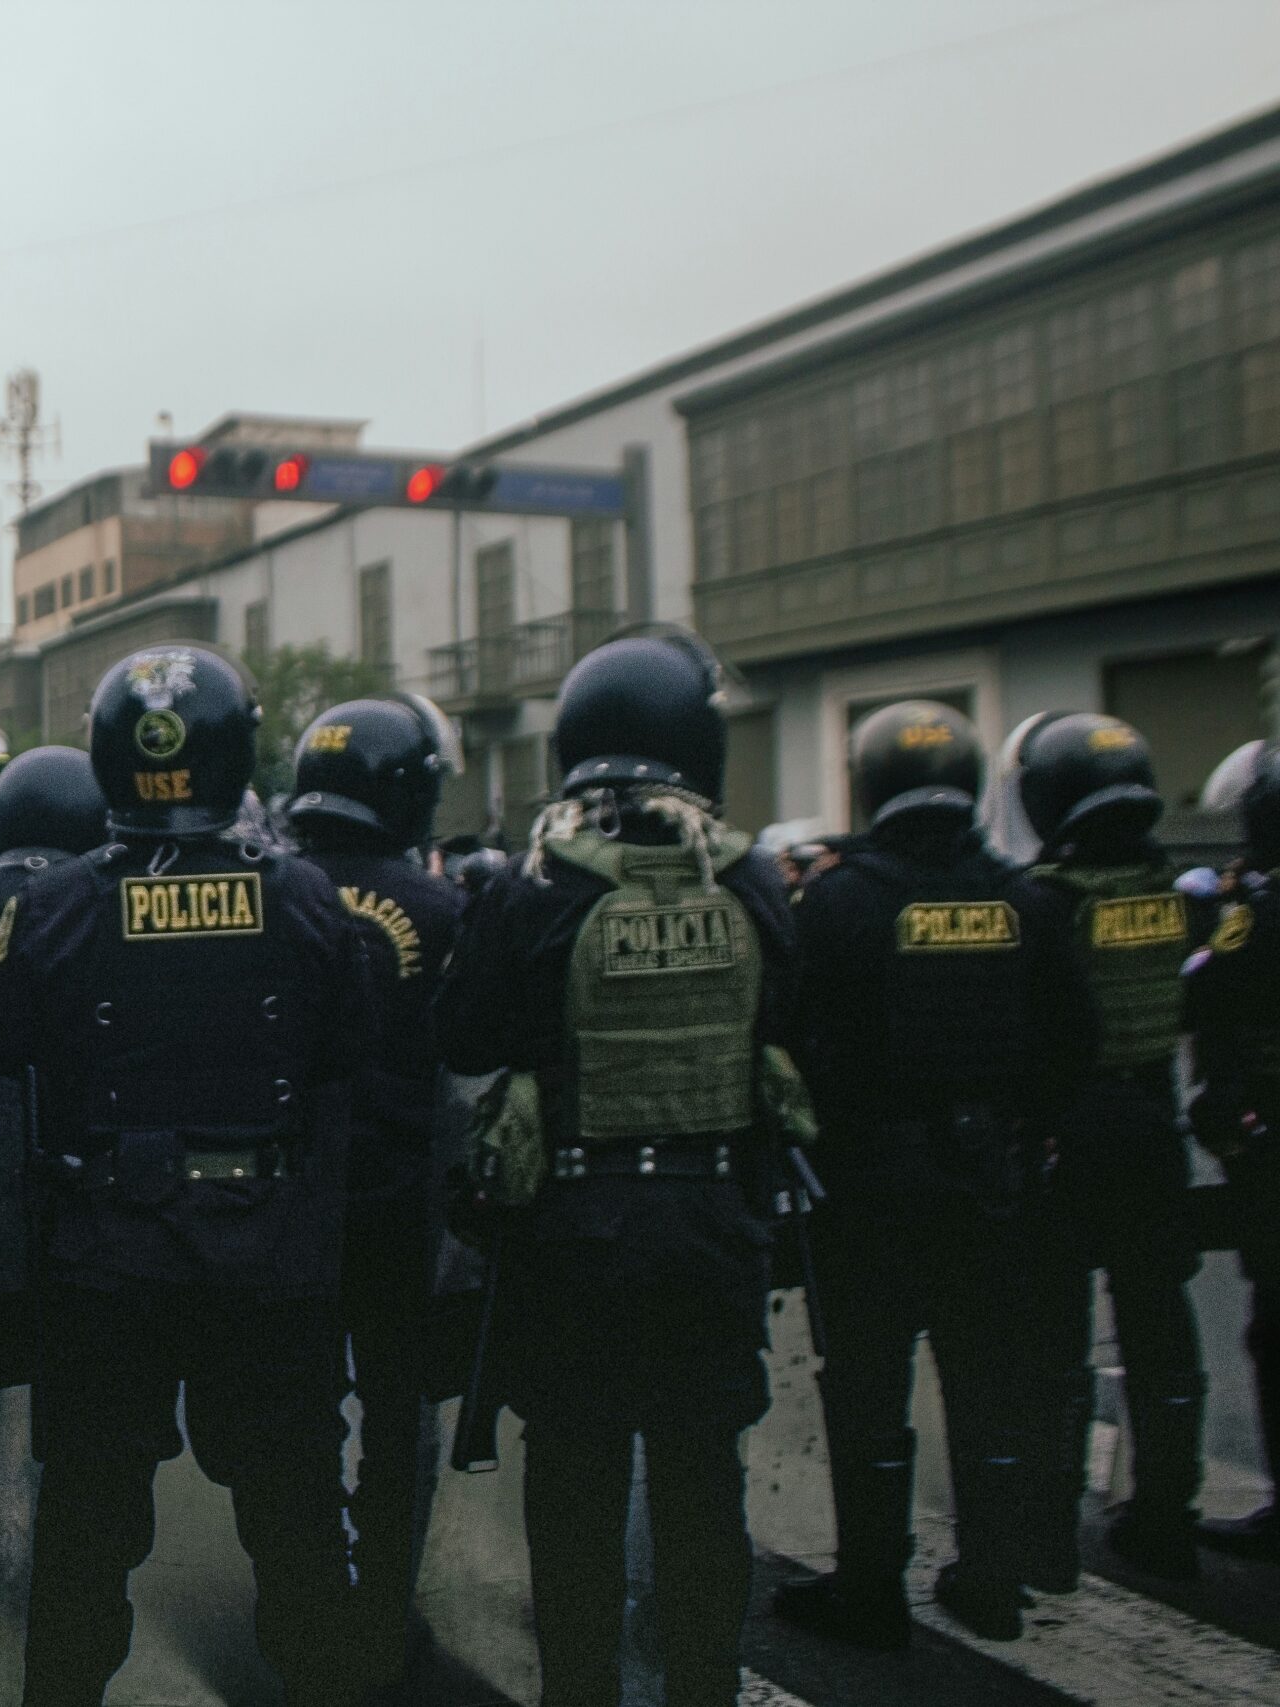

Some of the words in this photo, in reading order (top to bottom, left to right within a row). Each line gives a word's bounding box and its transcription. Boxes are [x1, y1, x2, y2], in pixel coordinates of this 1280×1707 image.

[134, 770, 192, 800] USE
[130, 880, 255, 931] POLICIA
[910, 906, 1013, 943] POLICIA
[336, 886, 423, 979] NACIONAL
[604, 909, 730, 954] POLICIA
